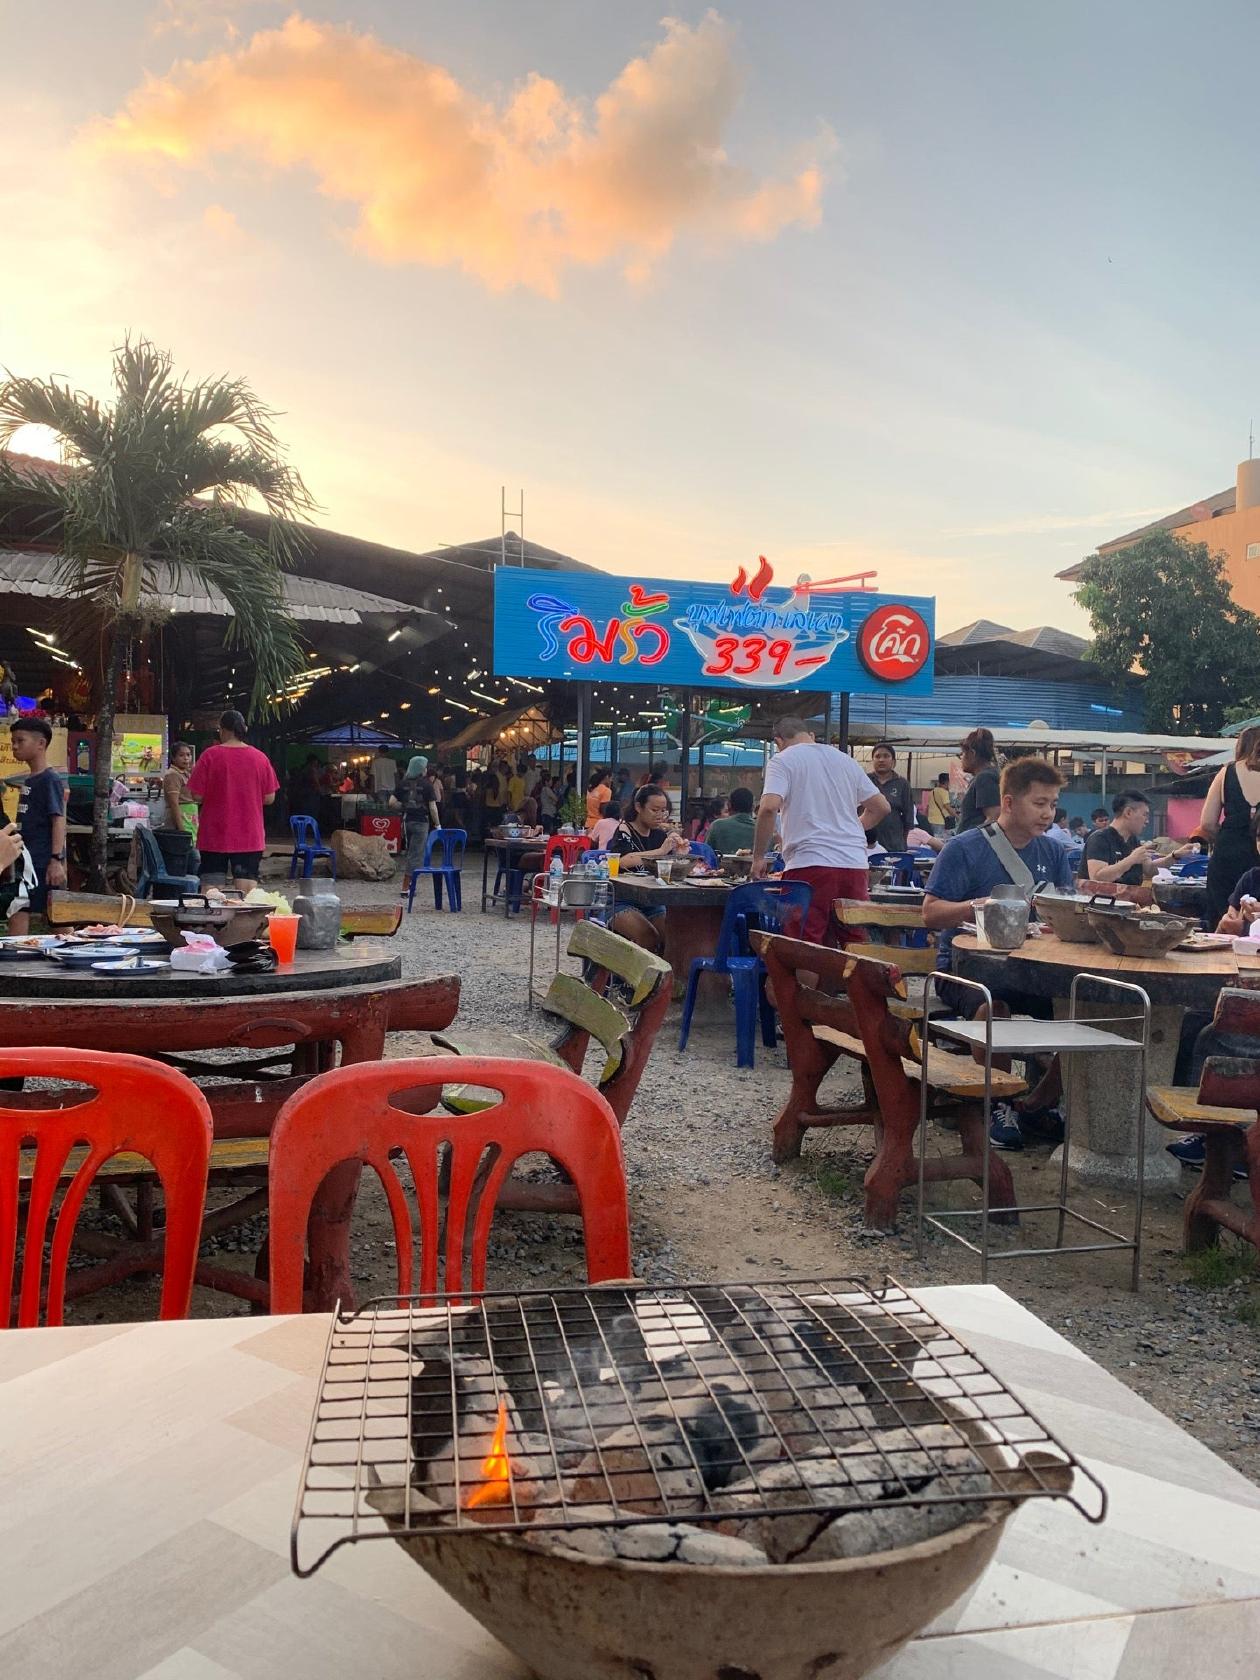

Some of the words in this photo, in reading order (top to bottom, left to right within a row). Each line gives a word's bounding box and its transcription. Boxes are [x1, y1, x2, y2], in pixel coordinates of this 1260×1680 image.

[527, 584, 670, 665] ริมรั้ว
[869, 614, 920, 663] โค้ก
